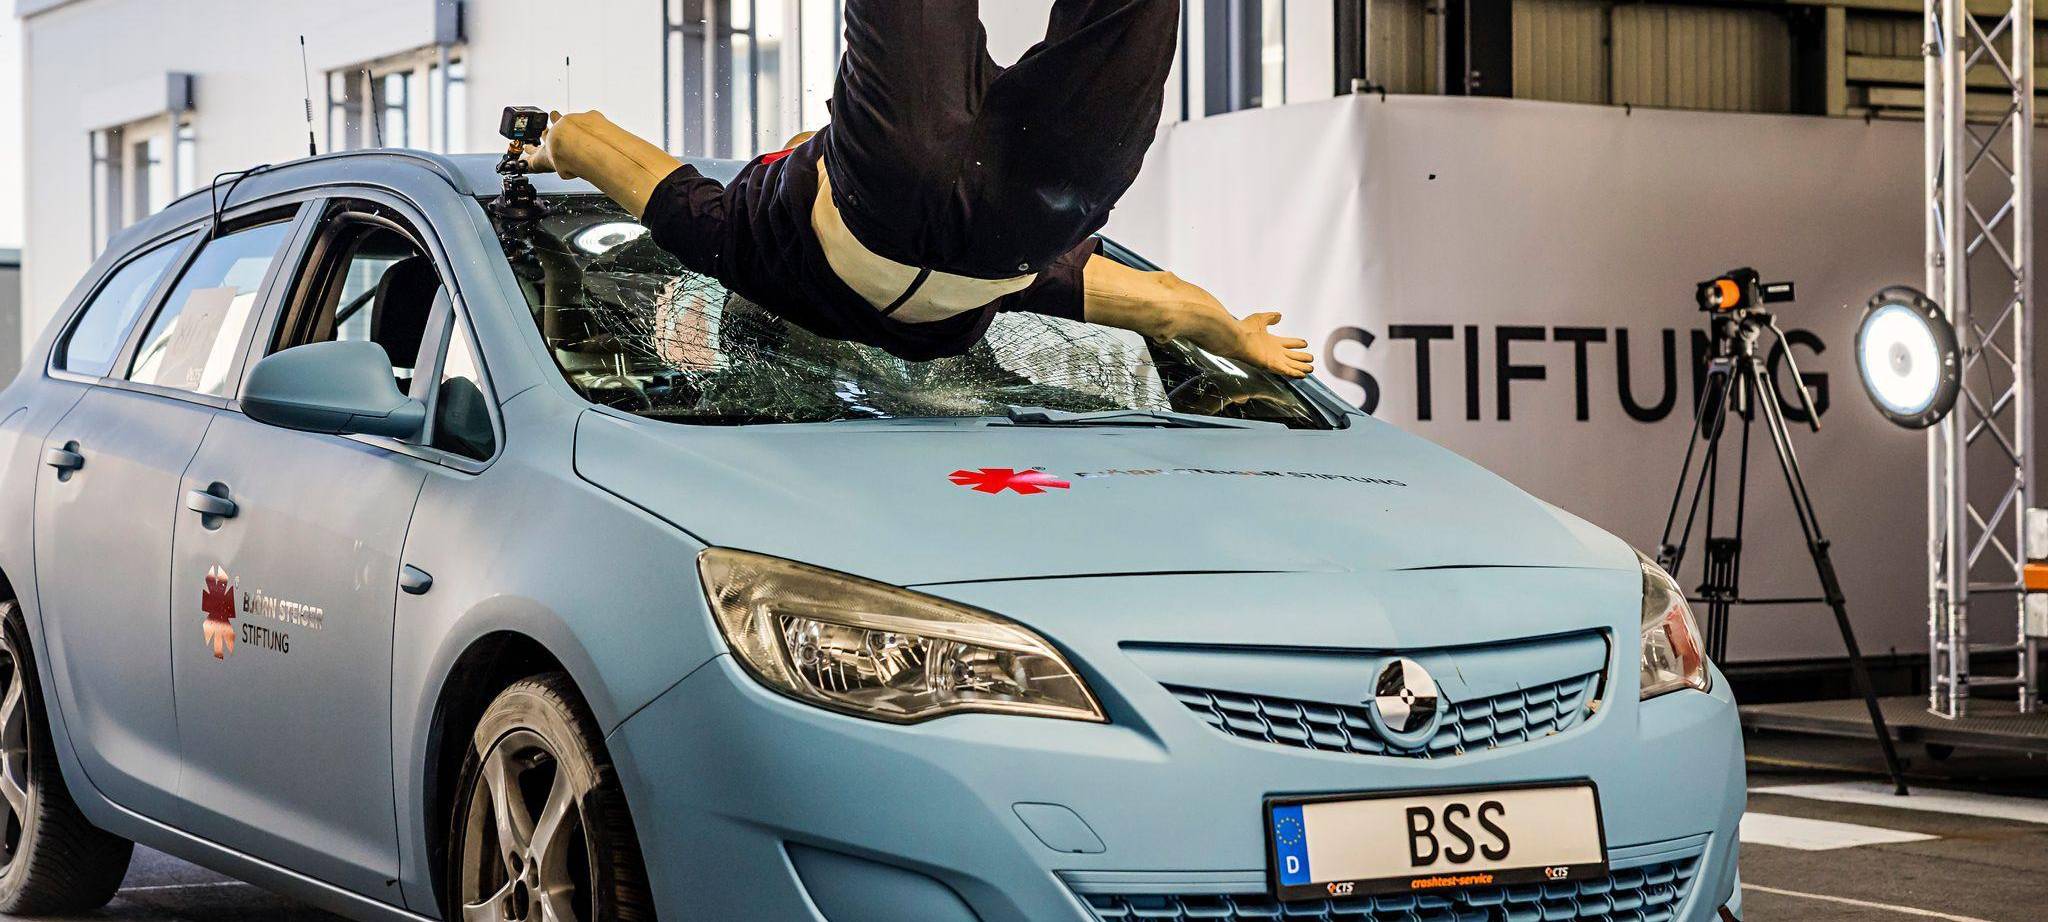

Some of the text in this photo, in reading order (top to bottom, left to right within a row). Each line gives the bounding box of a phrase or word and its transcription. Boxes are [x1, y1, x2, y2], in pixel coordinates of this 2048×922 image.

[1324, 324, 1830, 423] STIFTUNG
[1286, 471, 1407, 487] STIFTUNG
[243, 588, 277, 619] BJÖRN
[242, 623, 289, 654] STIFTUNG
[1406, 801, 1511, 867] BSS
[1286, 855, 1300, 874] D
[1335, 882, 1355, 893] CTS
[1411, 873, 1493, 889] crashtest-service
